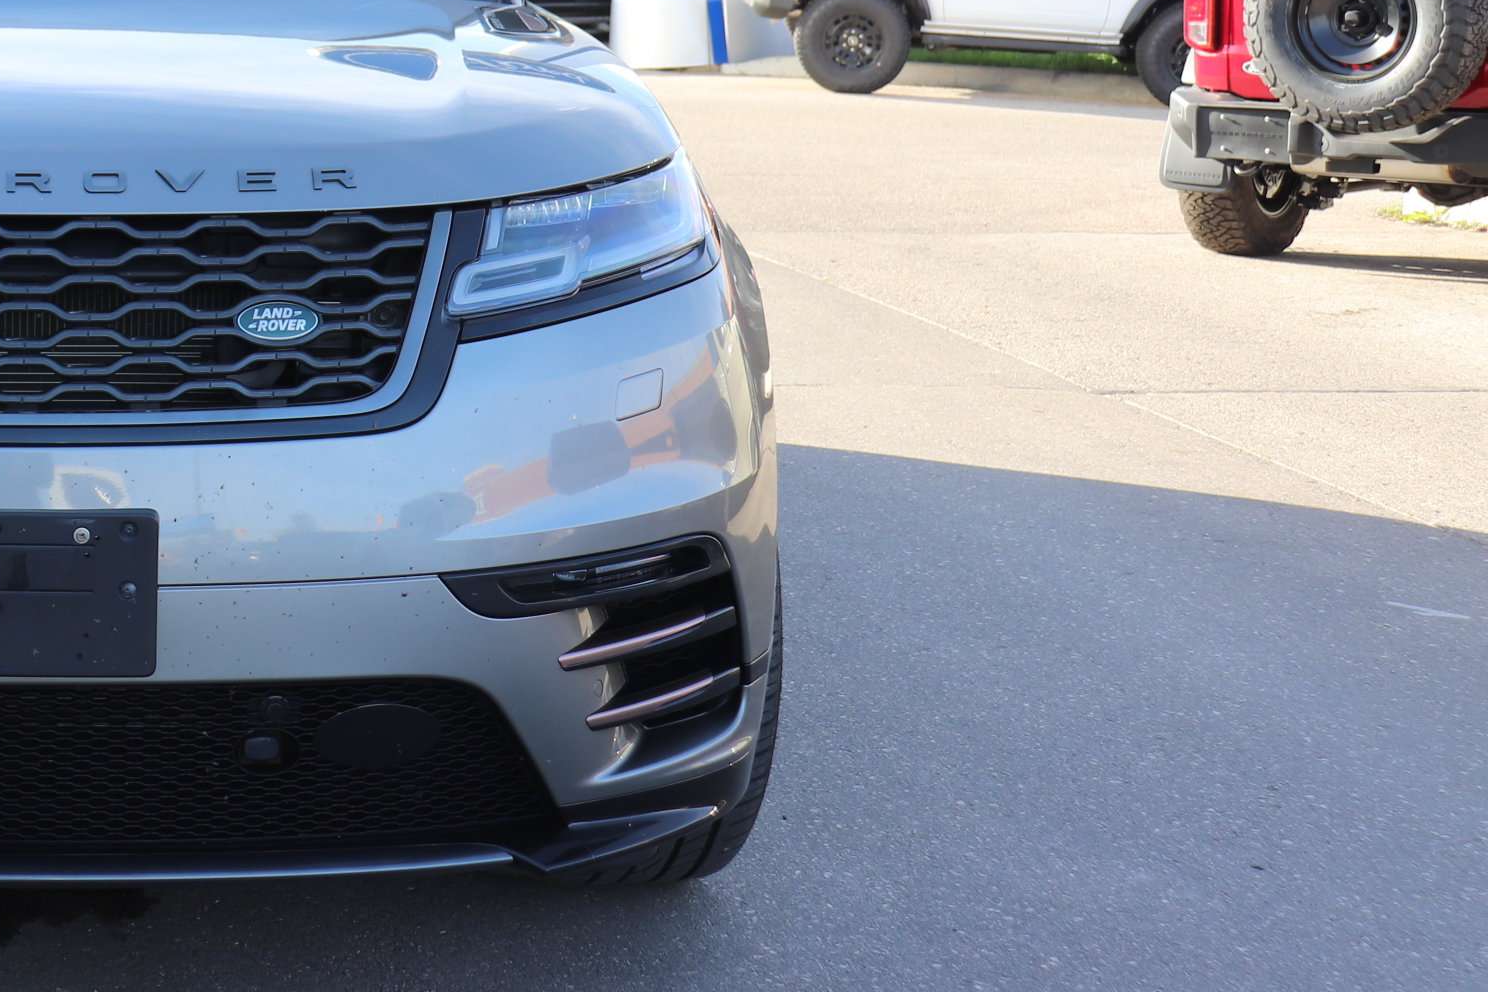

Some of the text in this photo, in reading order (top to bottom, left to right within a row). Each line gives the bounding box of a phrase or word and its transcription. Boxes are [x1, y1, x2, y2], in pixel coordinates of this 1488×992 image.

[6, 167, 358, 194] ROVER
[252, 307, 293, 320] LAND
[257, 319, 307, 332] ROVER
